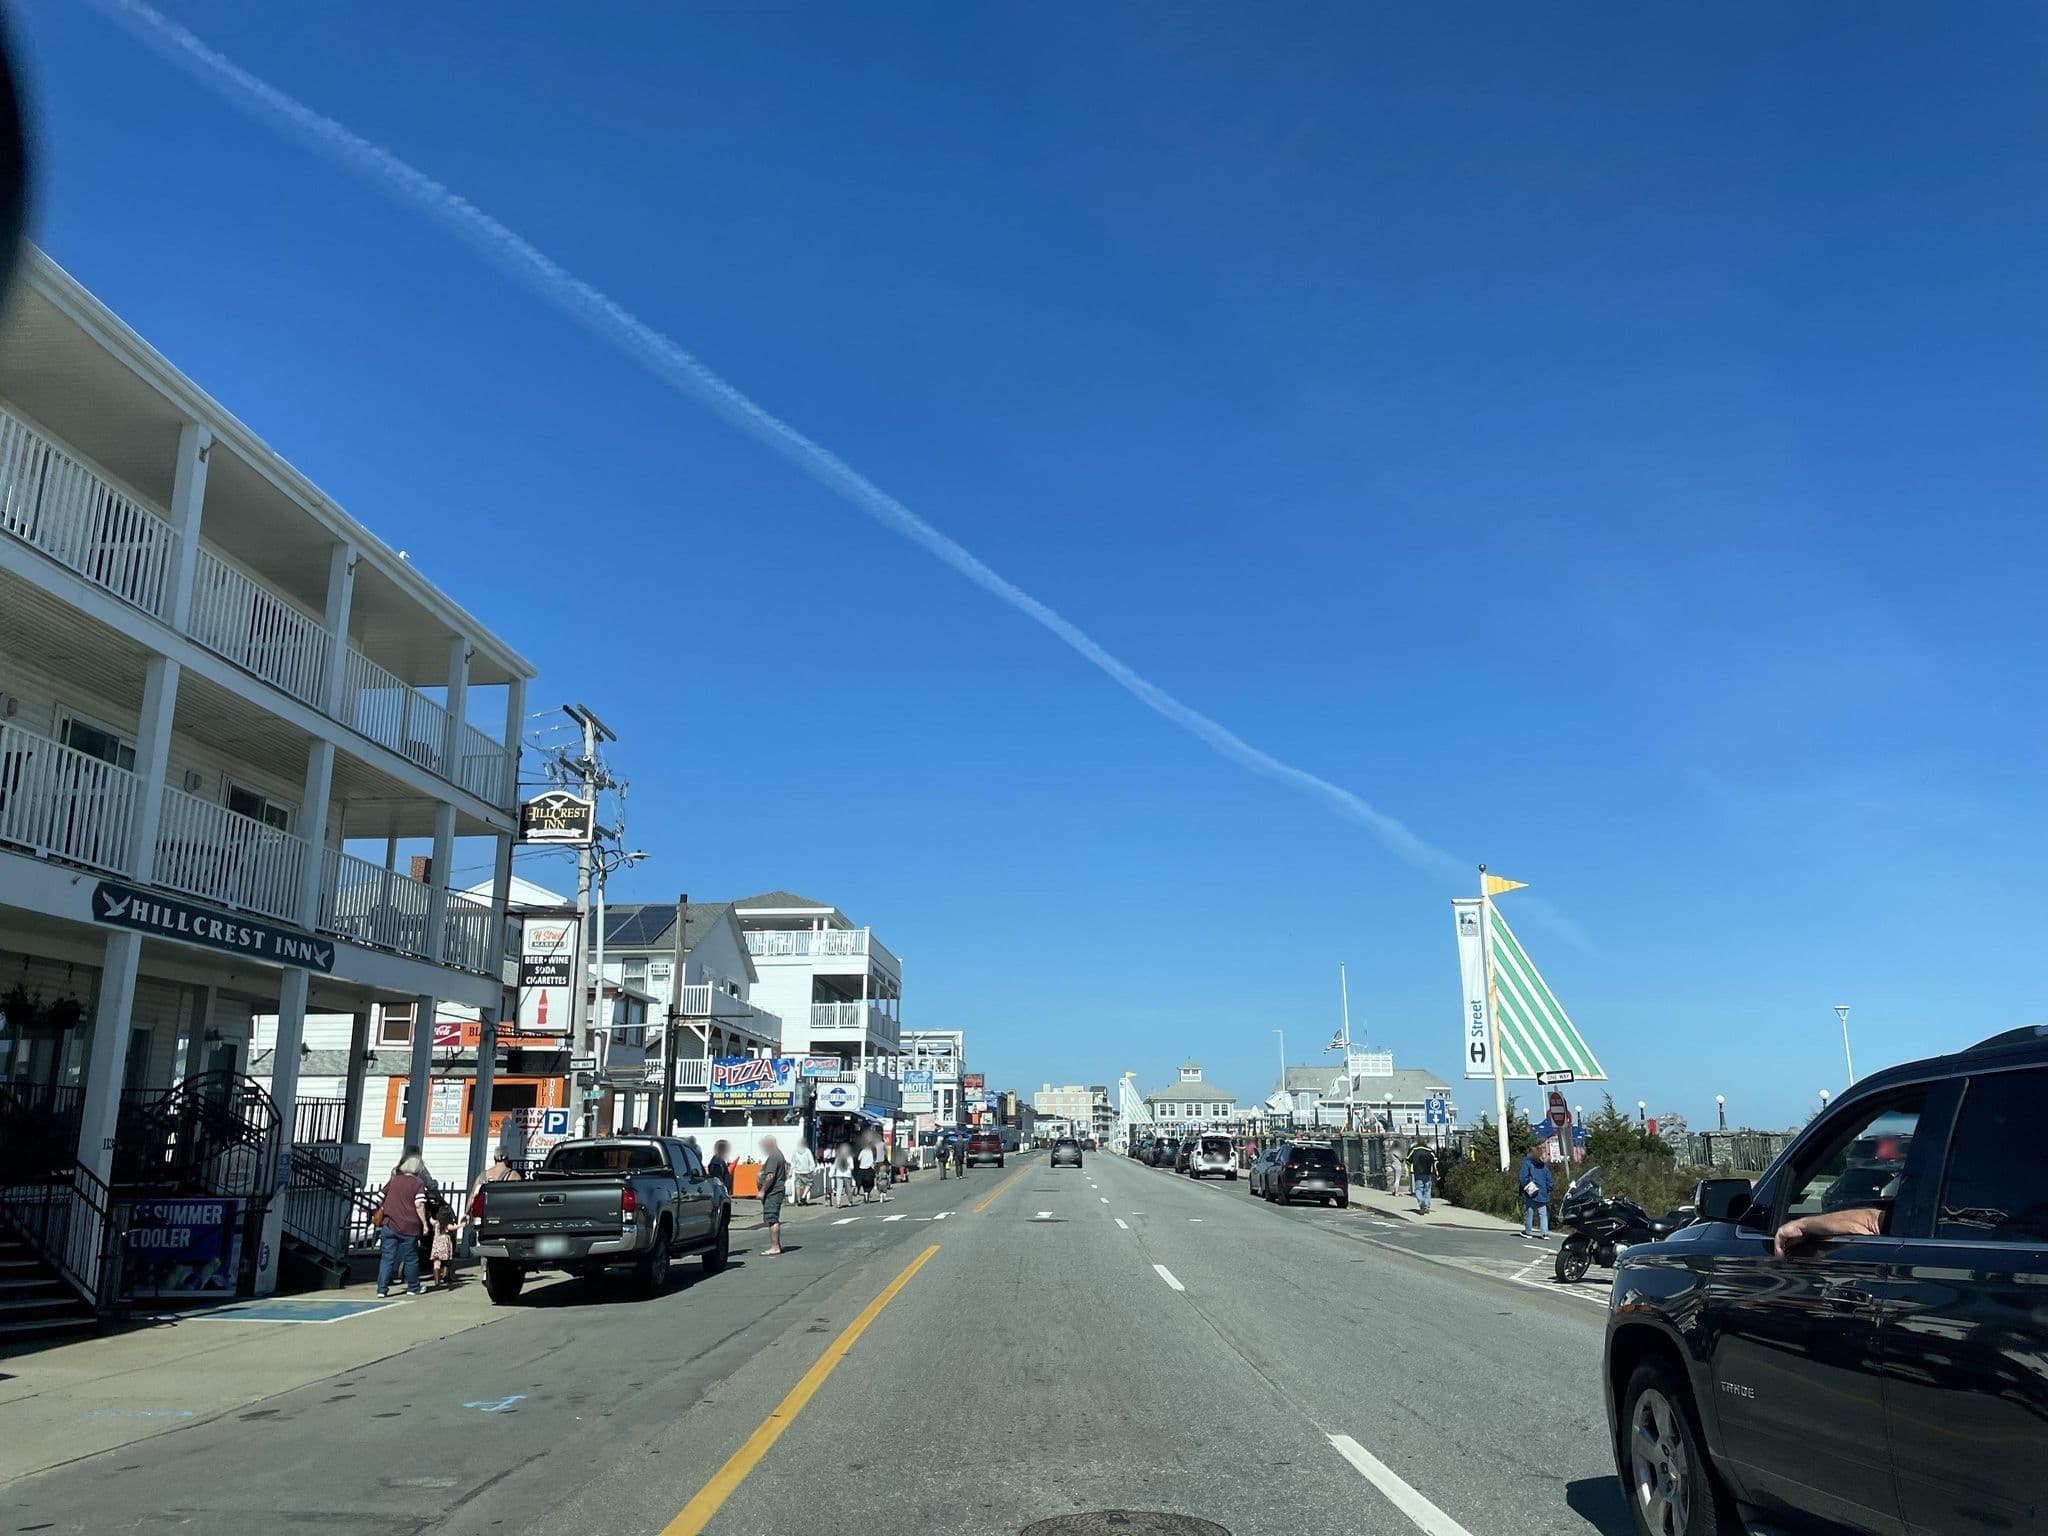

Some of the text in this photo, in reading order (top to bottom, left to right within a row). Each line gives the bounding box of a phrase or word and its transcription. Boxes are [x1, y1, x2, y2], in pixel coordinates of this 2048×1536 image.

[525, 807, 588, 821] HILLCREST
[544, 820, 566, 829] INN
[131, 900, 313, 961] HILLCREST INN
[535, 966, 556, 974] SODA
[525, 976, 567, 985] CIGARETTES
[1470, 1000, 1486, 1063] H Street
[713, 1059, 775, 1086] PIZZA
[904, 1082, 932, 1092] MOTEL
[548, 1113, 565, 1133] P
[512, 1161, 534, 1169] BEER
[154, 1204, 223, 1225] SUMMER
